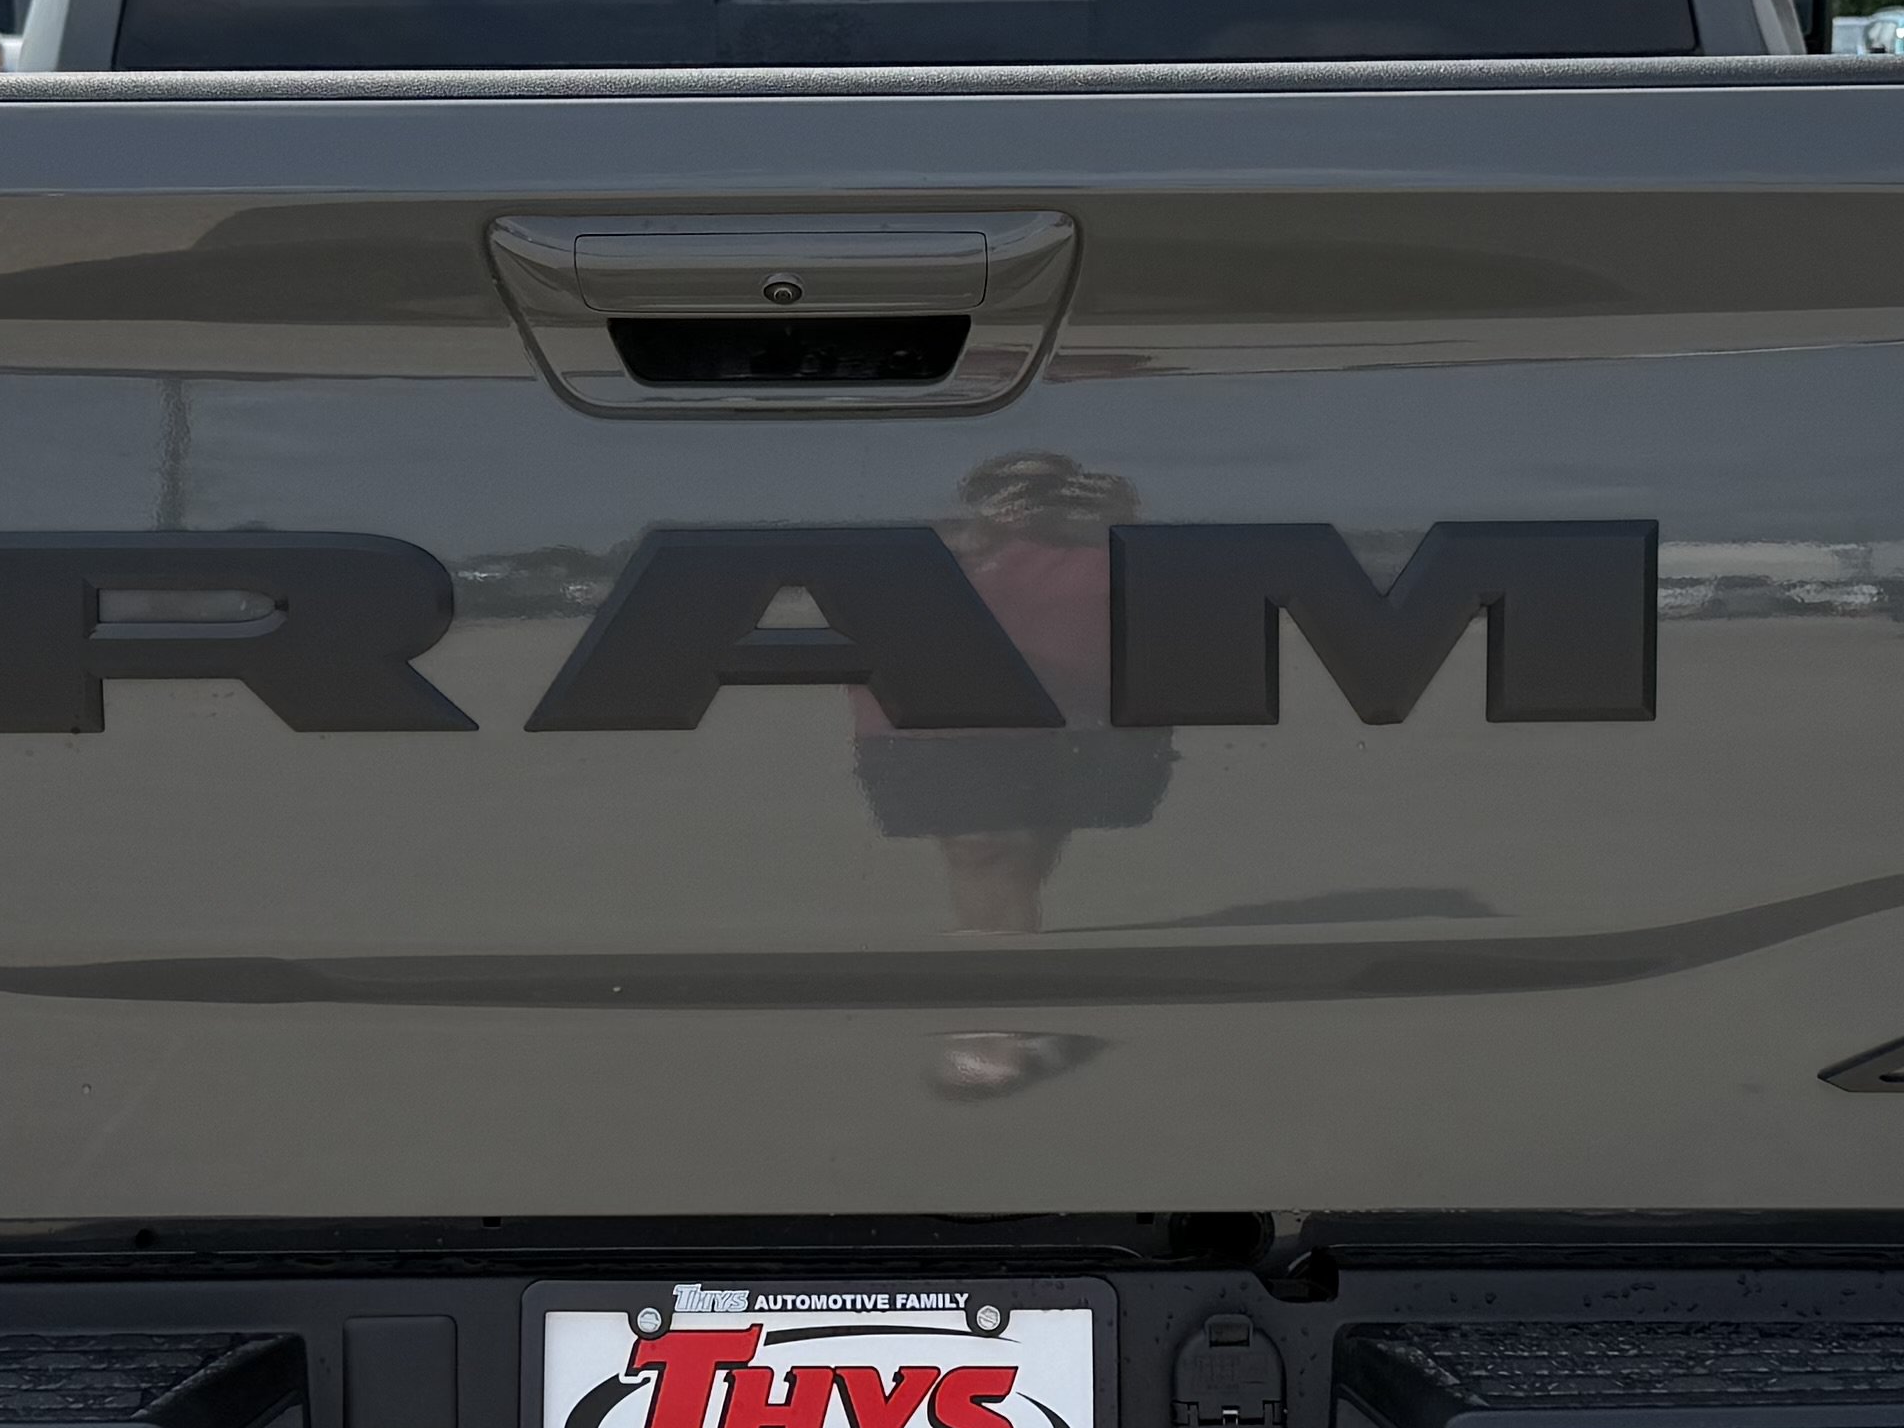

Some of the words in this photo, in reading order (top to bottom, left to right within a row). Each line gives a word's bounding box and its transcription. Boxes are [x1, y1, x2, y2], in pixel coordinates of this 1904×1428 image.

[672, 1283, 750, 1313] THYS
[754, 1292, 890, 1311] AUTOMOTIVE
[895, 1291, 969, 1310] FAMILY
